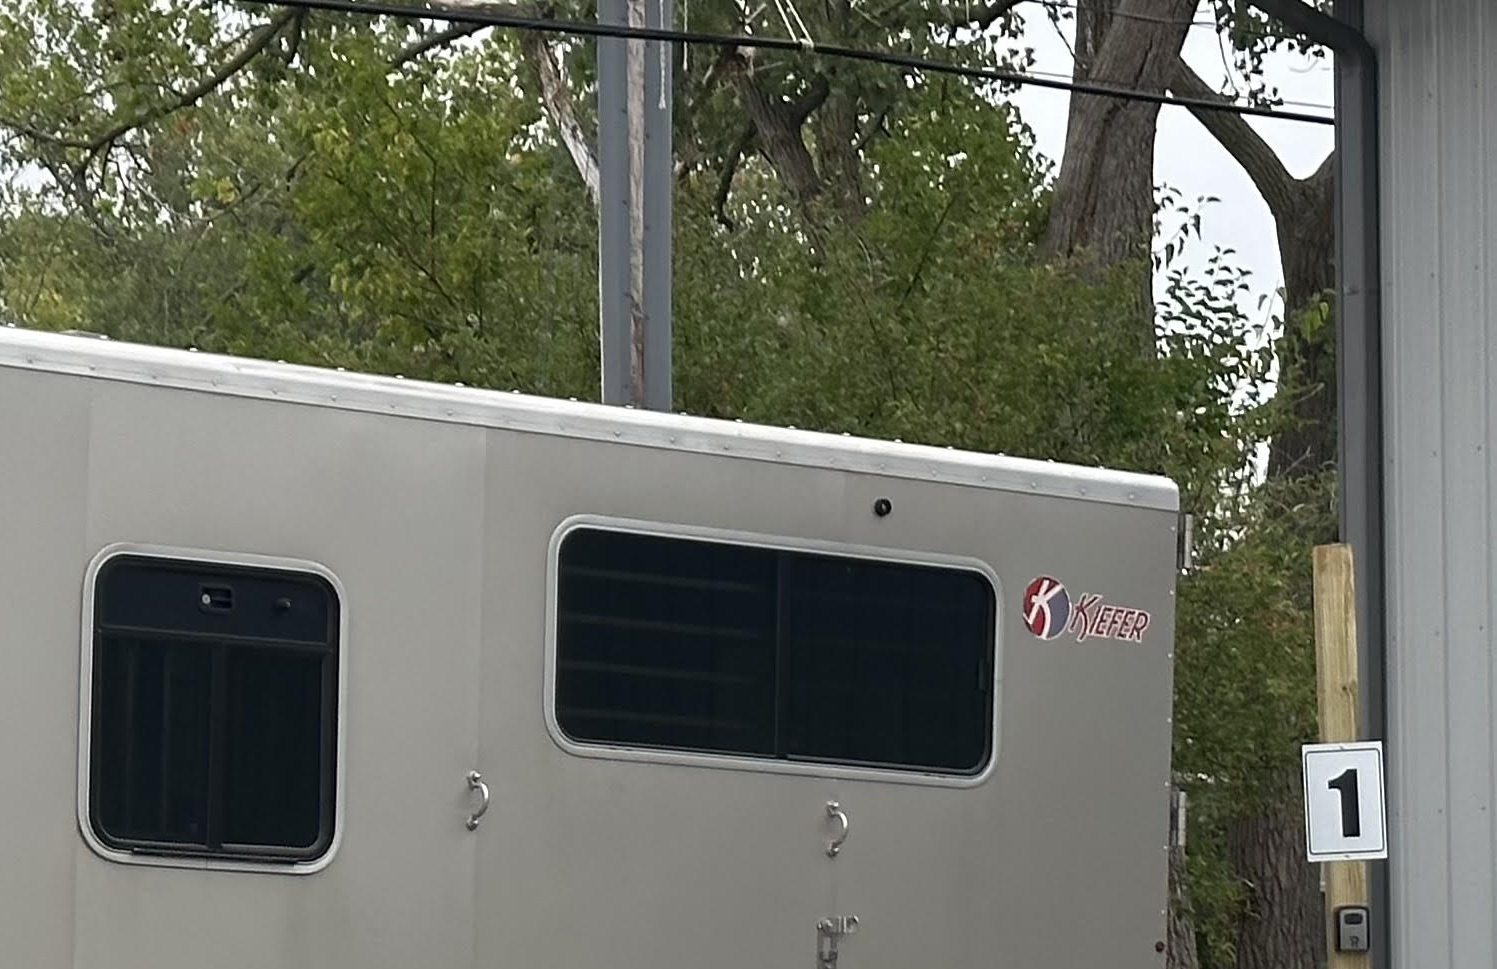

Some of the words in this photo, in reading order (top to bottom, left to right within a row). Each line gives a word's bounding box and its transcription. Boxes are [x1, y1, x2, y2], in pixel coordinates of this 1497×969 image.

[1023, 579, 1064, 640] K
[1068, 592, 1151, 642] KIEFER
[1327, 768, 1361, 838] 1
